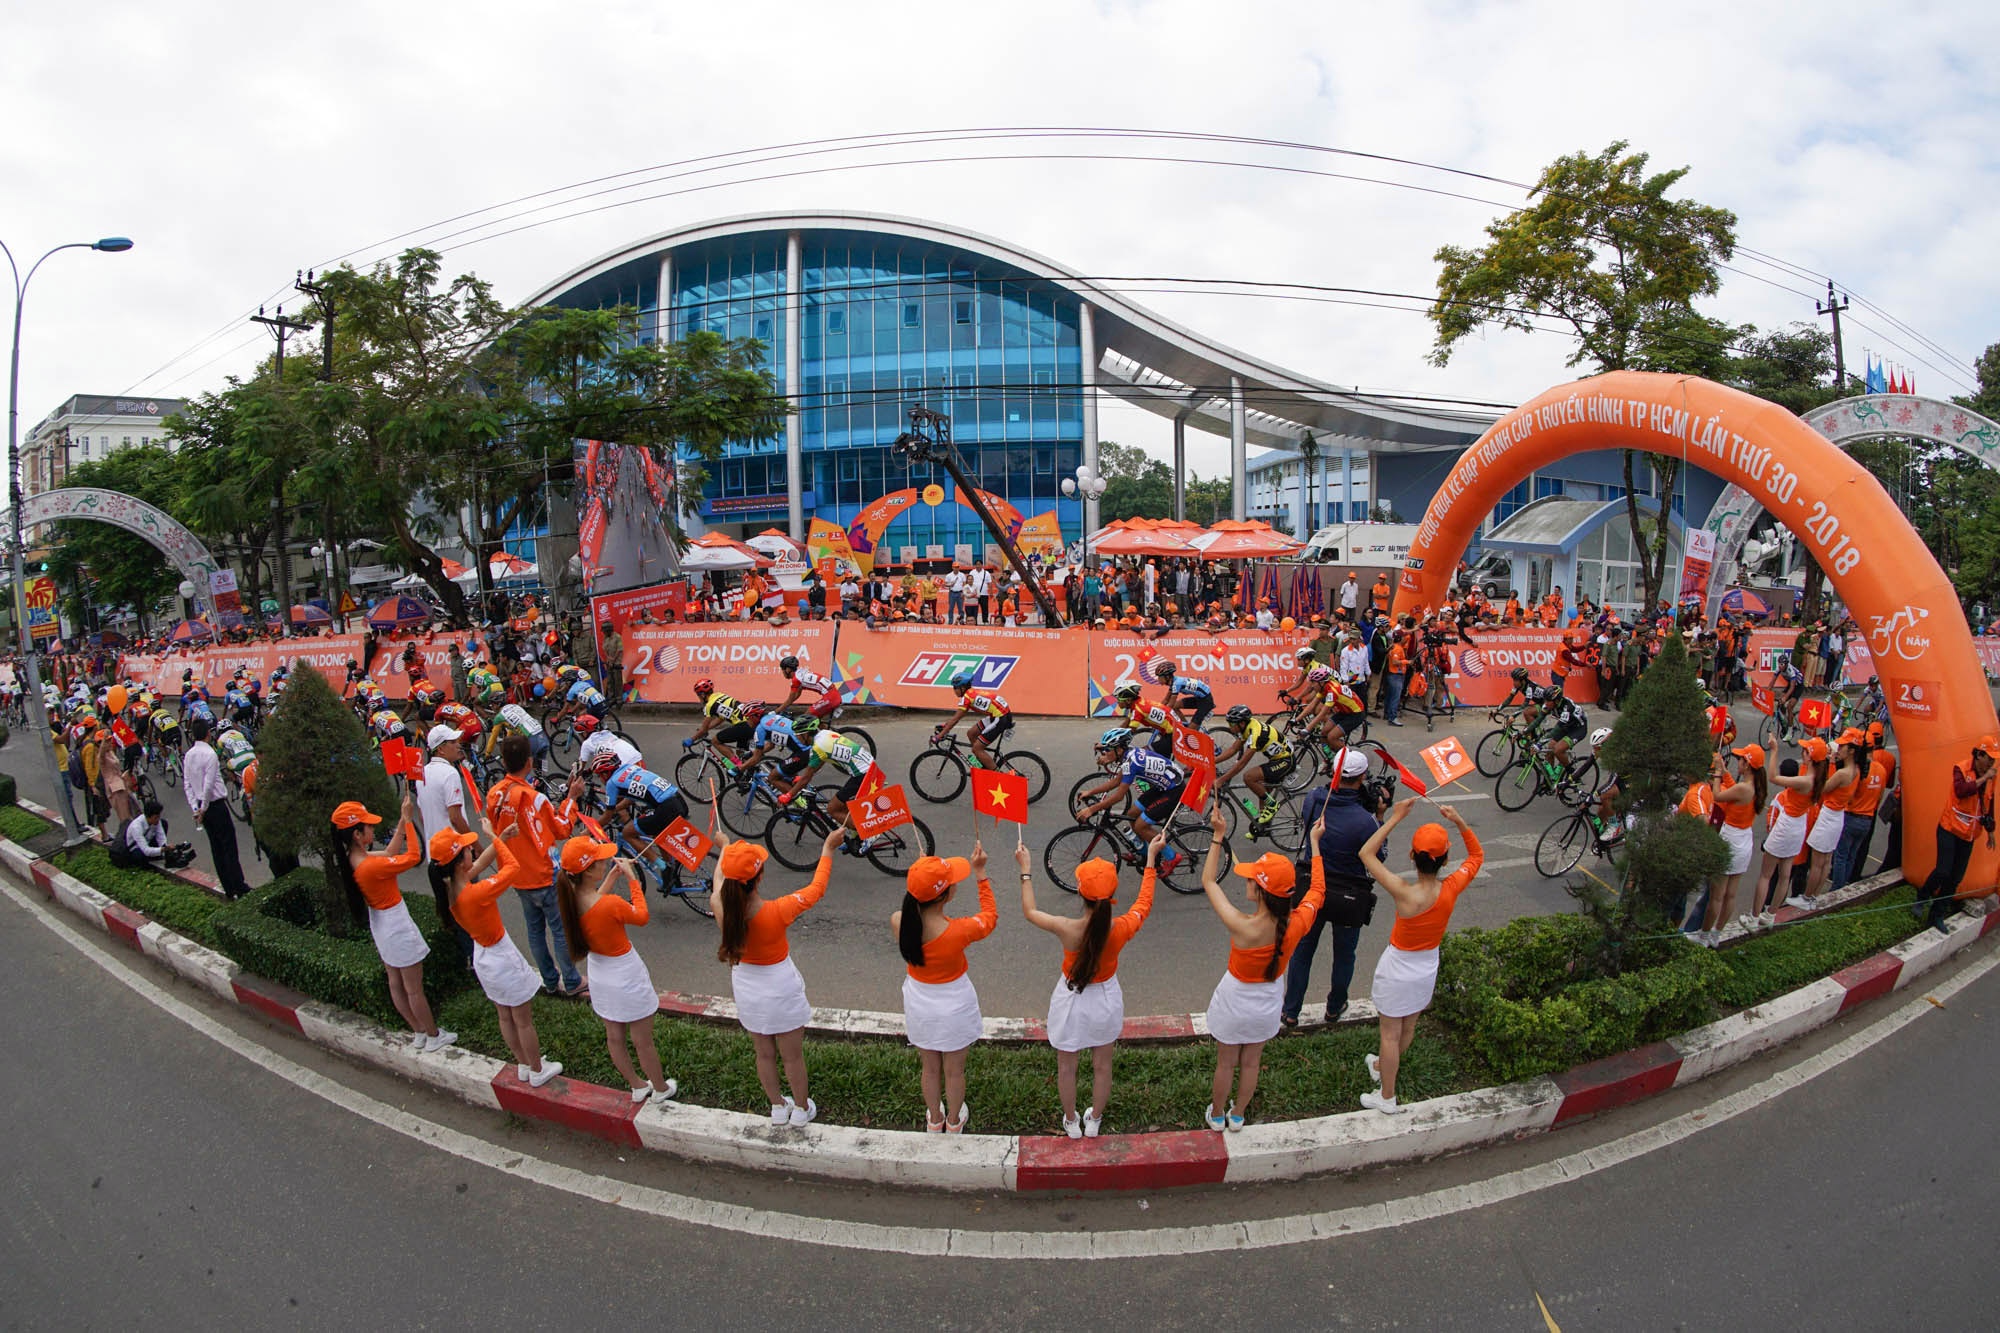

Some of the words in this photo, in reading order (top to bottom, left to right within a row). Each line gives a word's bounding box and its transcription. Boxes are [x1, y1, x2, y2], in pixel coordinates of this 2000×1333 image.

[1418, 513, 1440, 549] CUỘC
[1433, 490, 1454, 521] ĐUA
[1458, 456, 1479, 486] ĐẠP
[1477, 431, 1513, 468] TRANH
[1511, 411, 1534, 443] CÚP
[1533, 391, 1586, 432] TRUYỀN
[1586, 392, 1625, 425] HÌNH
[1627, 399, 1647, 429] TP
[1650, 402, 1688, 441] HCM
[1690, 408, 1729, 460] LẦN
[1730, 434, 1772, 482] THỨ
[1766, 463, 1799, 505] 30
[1804, 500, 1862, 577] 2018
[1160, 638, 1182, 647] TRANH
[1905, 635, 1931, 648] NĂM
[319, 652, 346, 667] DONG
[685, 645, 727, 662] TON
[730, 644, 791, 662] DONG
[796, 644, 811, 662] A
[1487, 650, 1522, 666] TON
[1524, 650, 1557, 666] DON
[1176, 653, 1225, 671] TON
[1229, 652, 1294, 671] DONG
[722, 665, 745, 674] 2018
[904, 656, 1012, 685] HTV
[1224, 675, 1249, 685] 2018
[975, 697, 987, 709] 94
[719, 704, 731, 718] 75
[1150, 708, 1163, 721] 96
[773, 733, 785, 745] 31
[833, 745, 851, 760] 113
[1182, 750, 1203, 762] DONG
[1203, 756, 1210, 764] A
[1146, 758, 1165, 771] 105
[628, 782, 647, 798] 33
[861, 820, 877, 829] TON
[877, 811, 900, 824] DONG
[666, 835, 677, 847] TON
[675, 843, 693, 860] DONG
[691, 855, 698, 863] A
